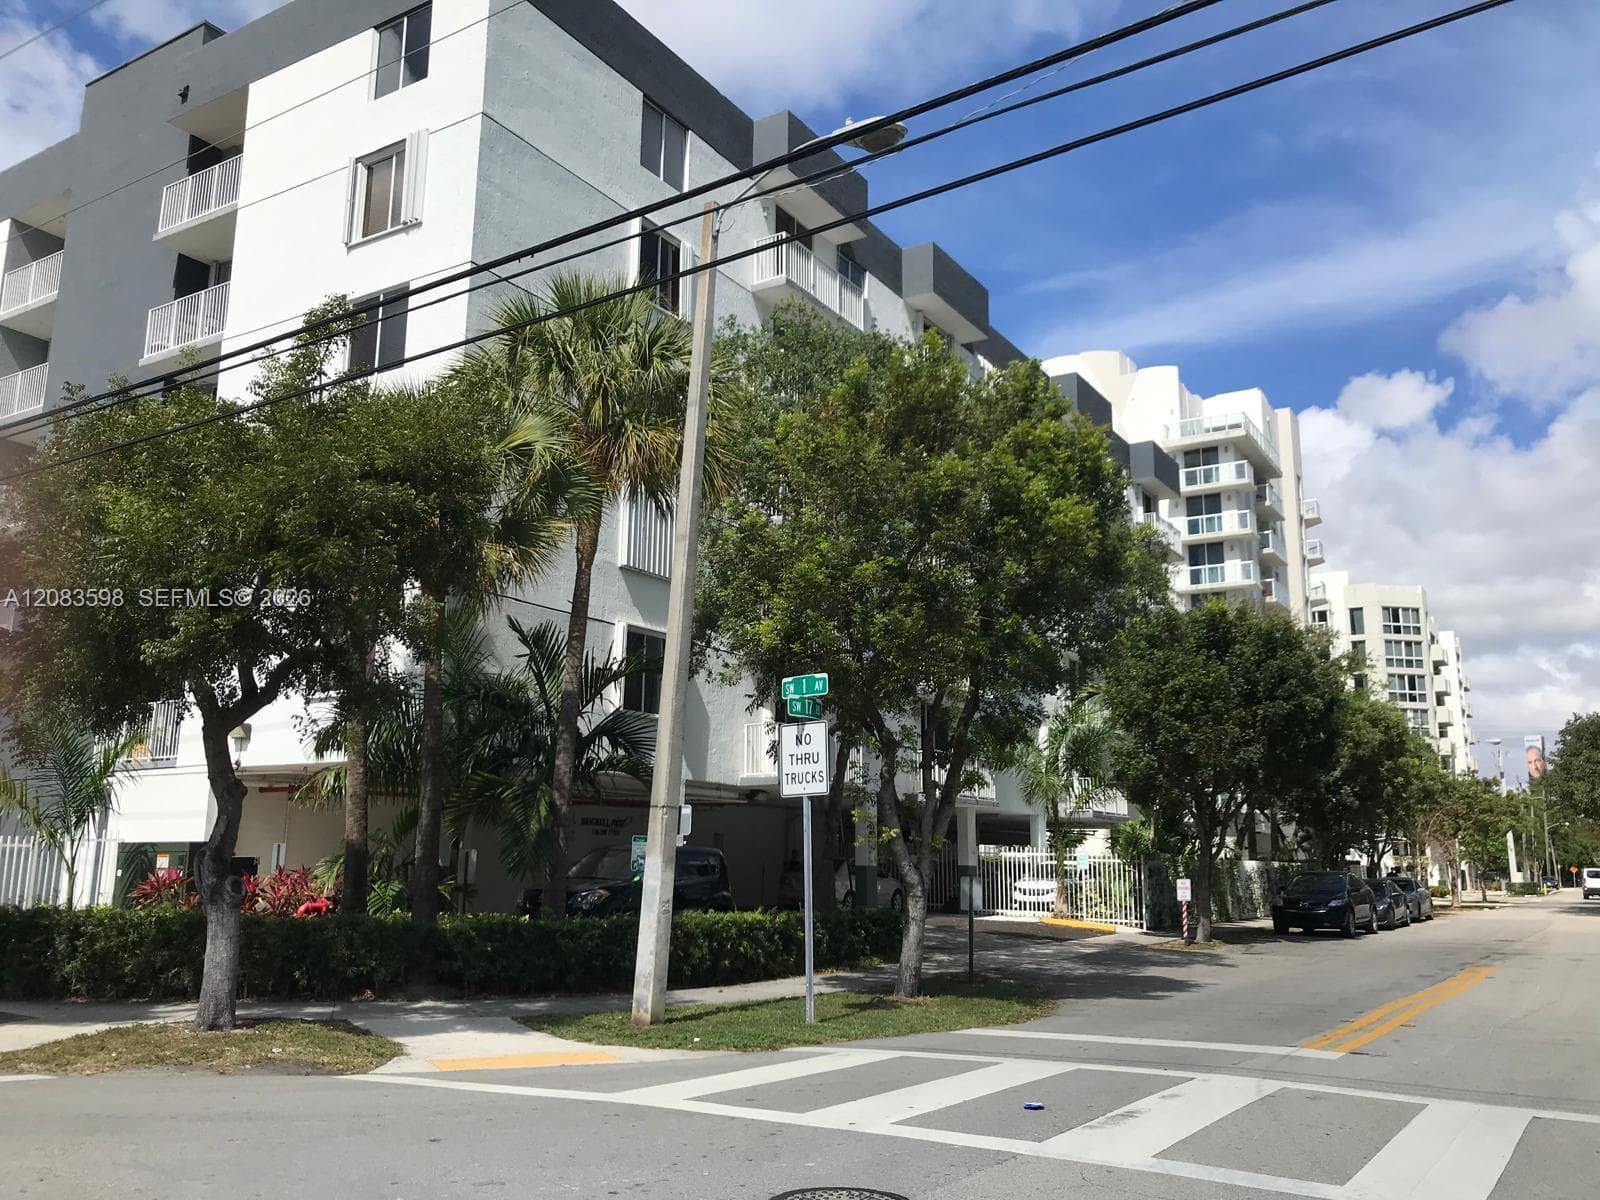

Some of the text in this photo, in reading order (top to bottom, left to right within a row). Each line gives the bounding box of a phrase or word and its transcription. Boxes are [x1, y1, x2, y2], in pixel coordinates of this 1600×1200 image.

[785, 678, 824, 694] SW 1 AV
[792, 701, 801, 713] SW
[805, 699, 814, 716] 17
[795, 733, 812, 746] NO
[789, 752, 820, 766] THRU
[785, 770, 825, 785] TRUCKS
